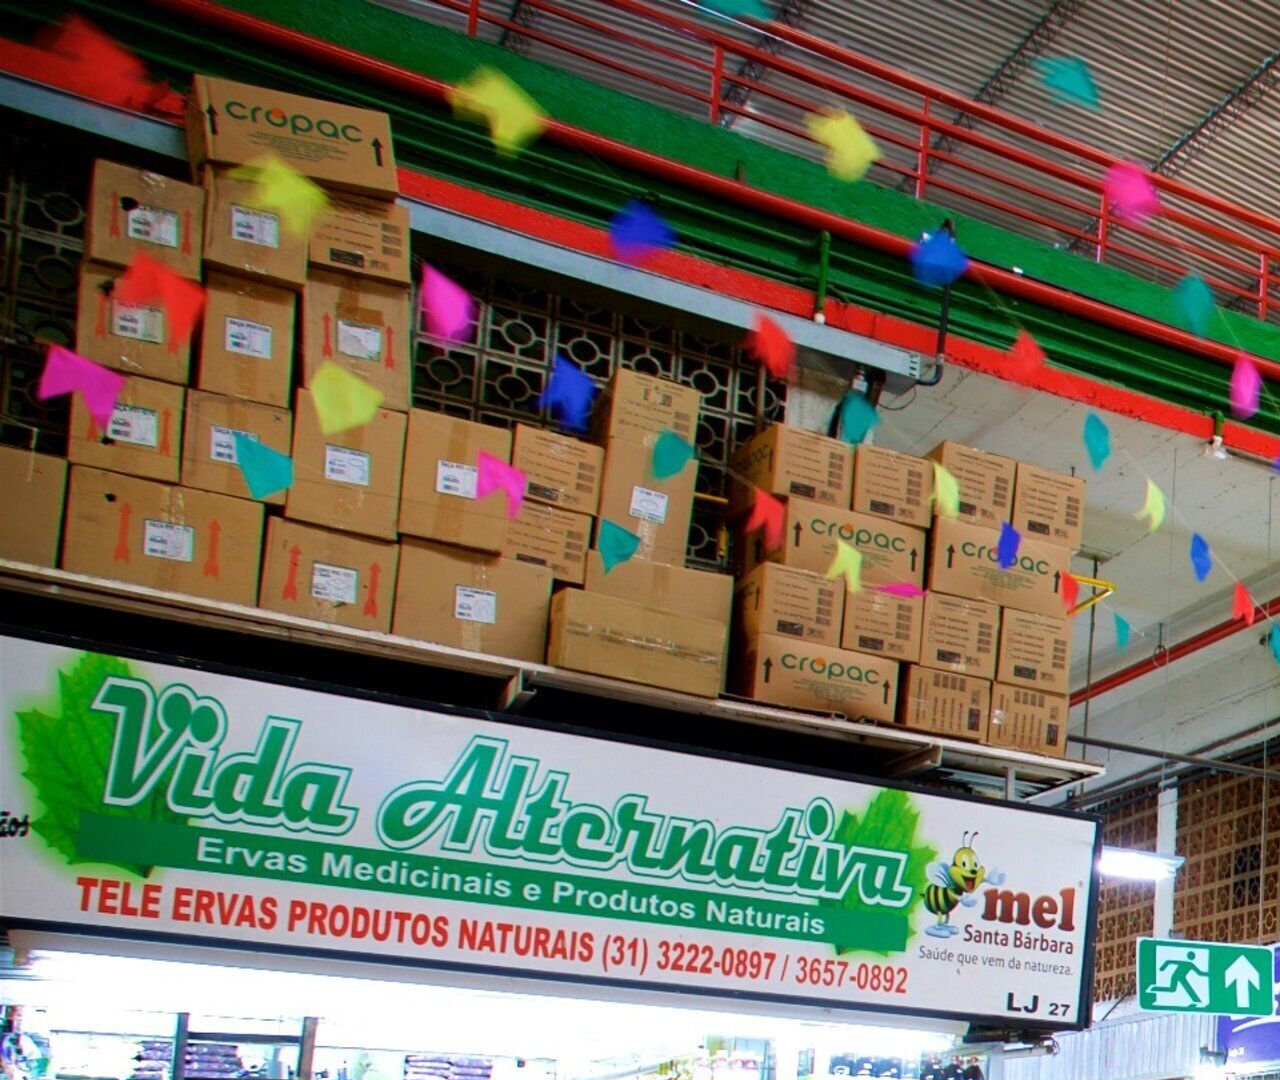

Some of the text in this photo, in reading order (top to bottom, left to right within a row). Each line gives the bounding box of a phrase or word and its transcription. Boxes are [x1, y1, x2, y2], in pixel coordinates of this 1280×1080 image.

[225, 101, 363, 143] cropac
[808, 518, 906, 553] cropac
[780, 652, 880, 685] cropac
[92, 677, 914, 909] Vida Alternativa
[197, 836, 826, 934] Ervas Medicinais e Produtos Naturais
[981, 886, 1076, 932] mel
[76, 877, 909, 994] TELE ERVAS PRODUTOS NATURAIS (31) 3222-0897 / 3657-0892
[963, 924, 1074, 954] Santa Bárbara
[918, 945, 1073, 976] Saúde que vem da natureza.
[1006, 992, 1071, 1017] LJ 27
